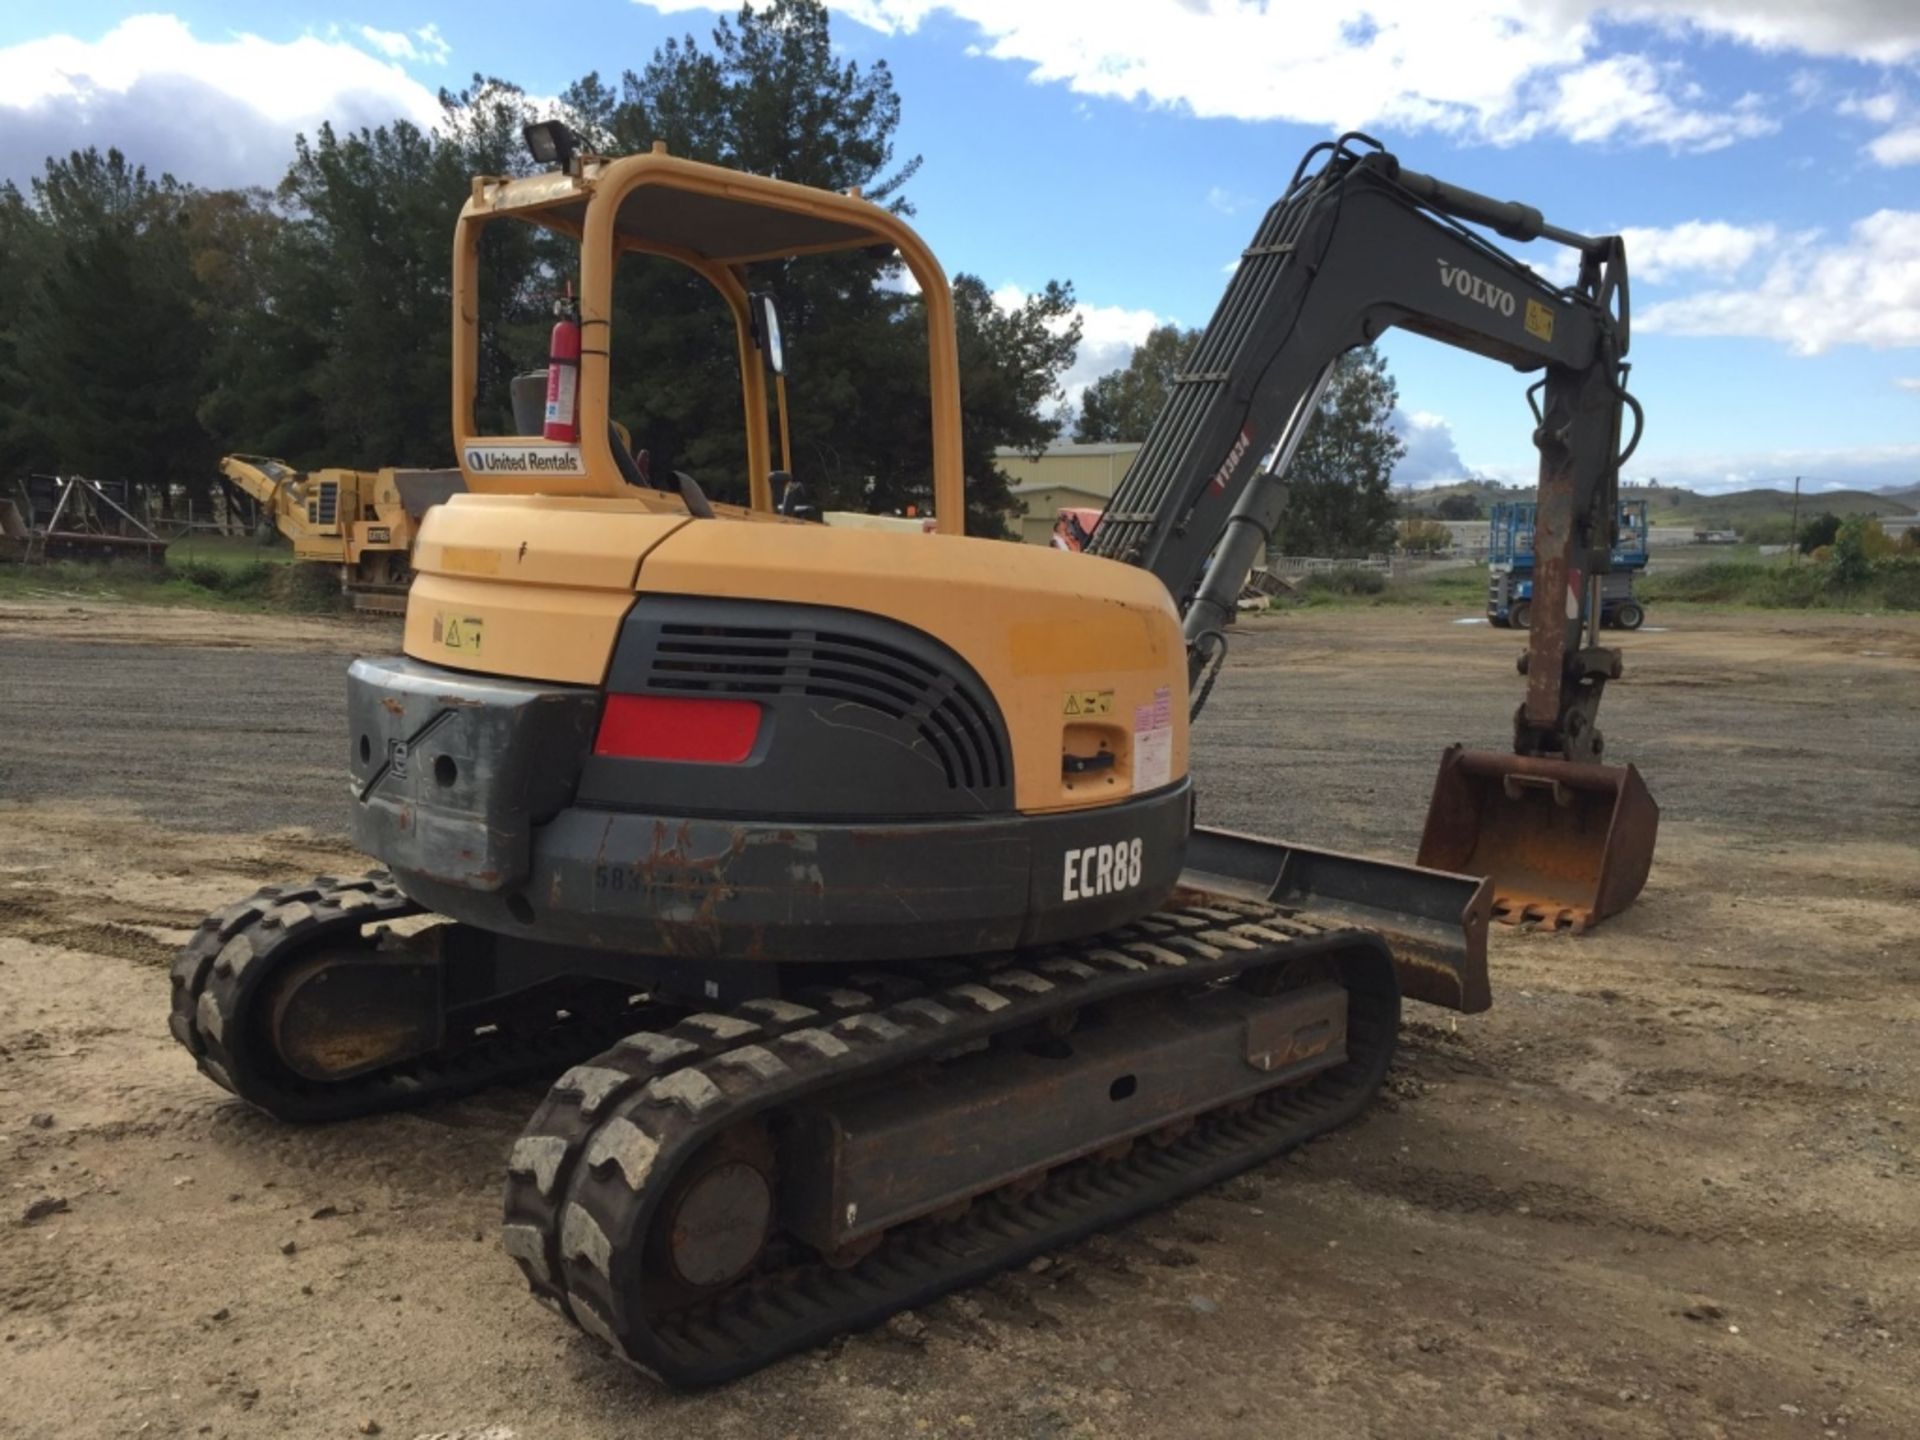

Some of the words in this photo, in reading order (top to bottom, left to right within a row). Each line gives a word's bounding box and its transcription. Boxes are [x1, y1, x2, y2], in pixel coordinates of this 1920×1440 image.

[1437, 258, 1516, 317] VOLVO
[484, 451, 526, 472] United
[528, 451, 579, 472] Rentals
[1062, 837, 1143, 902] ECR88
